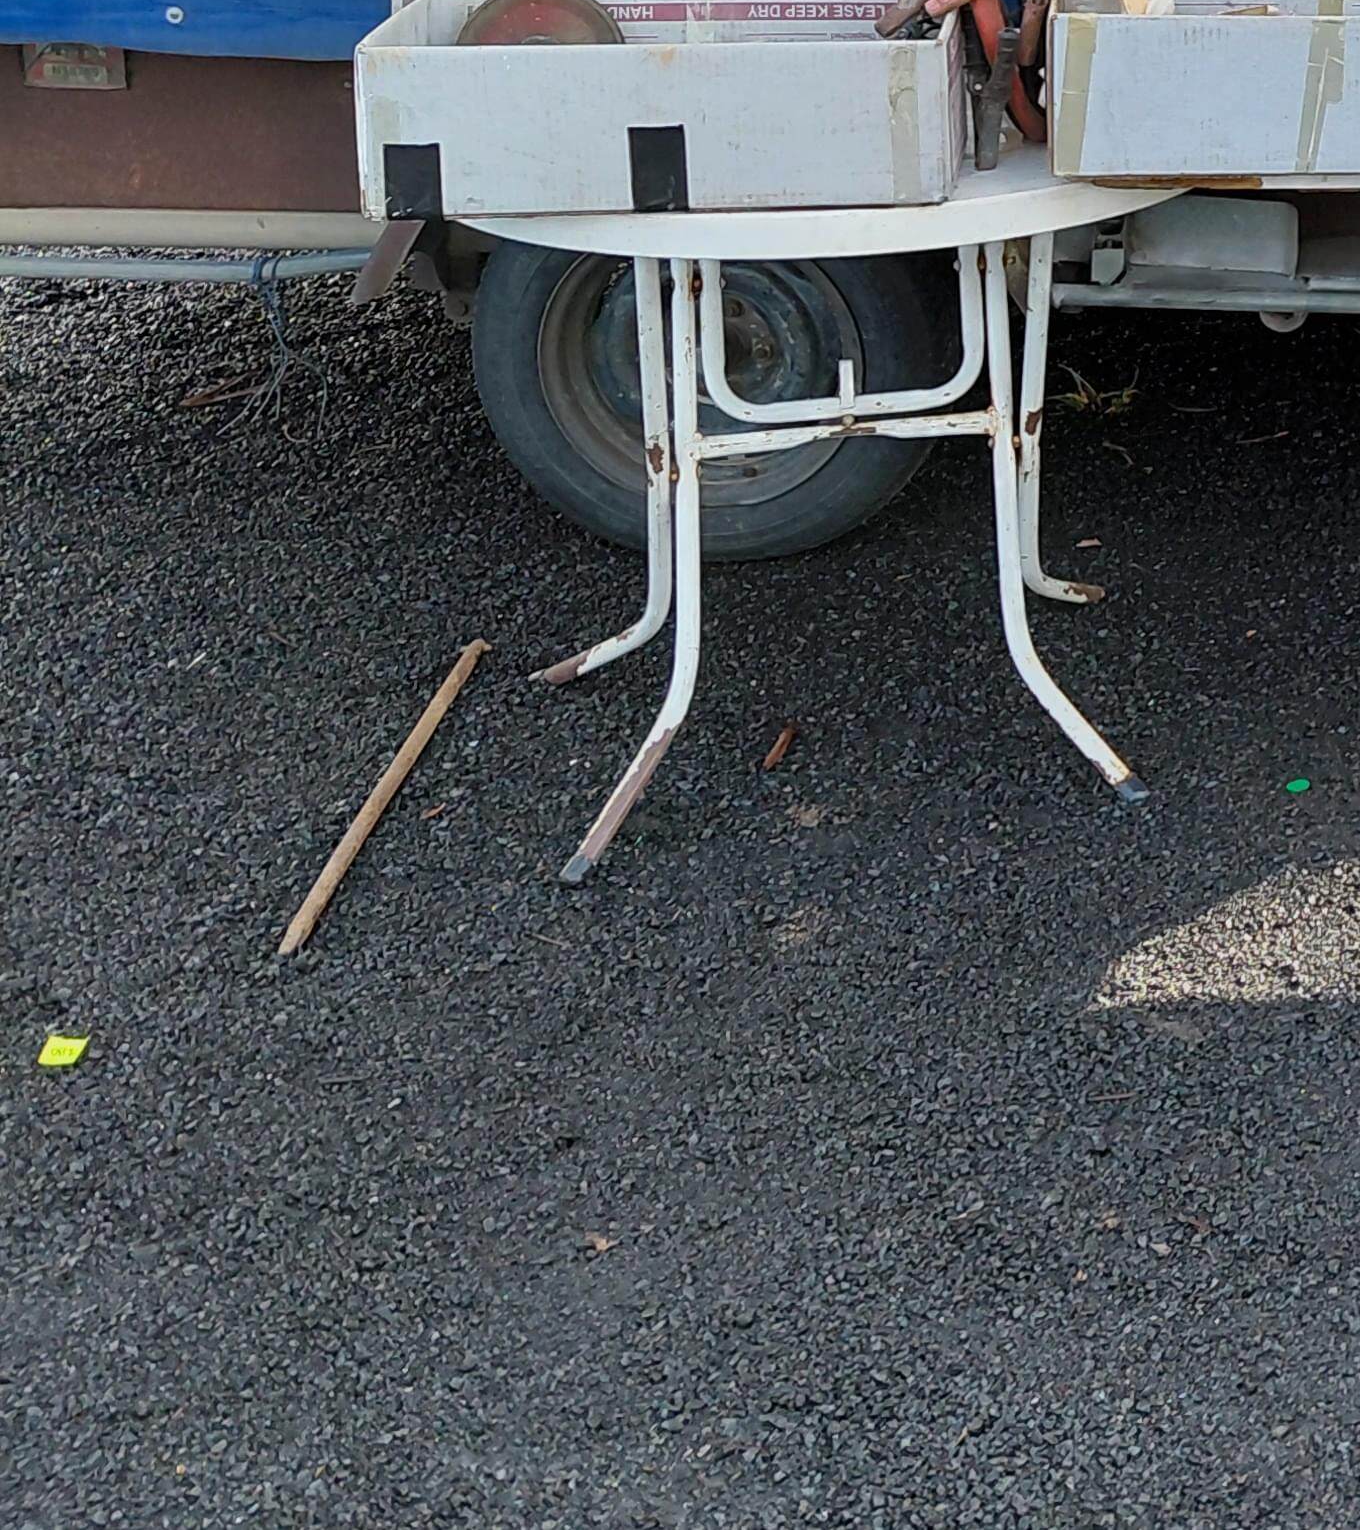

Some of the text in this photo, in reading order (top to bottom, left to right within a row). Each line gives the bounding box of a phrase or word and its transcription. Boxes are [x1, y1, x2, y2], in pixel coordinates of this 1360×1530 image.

[608, 6, 654, 19] HAND
[748, 4, 885, 18] LEASE KEEP DRY
